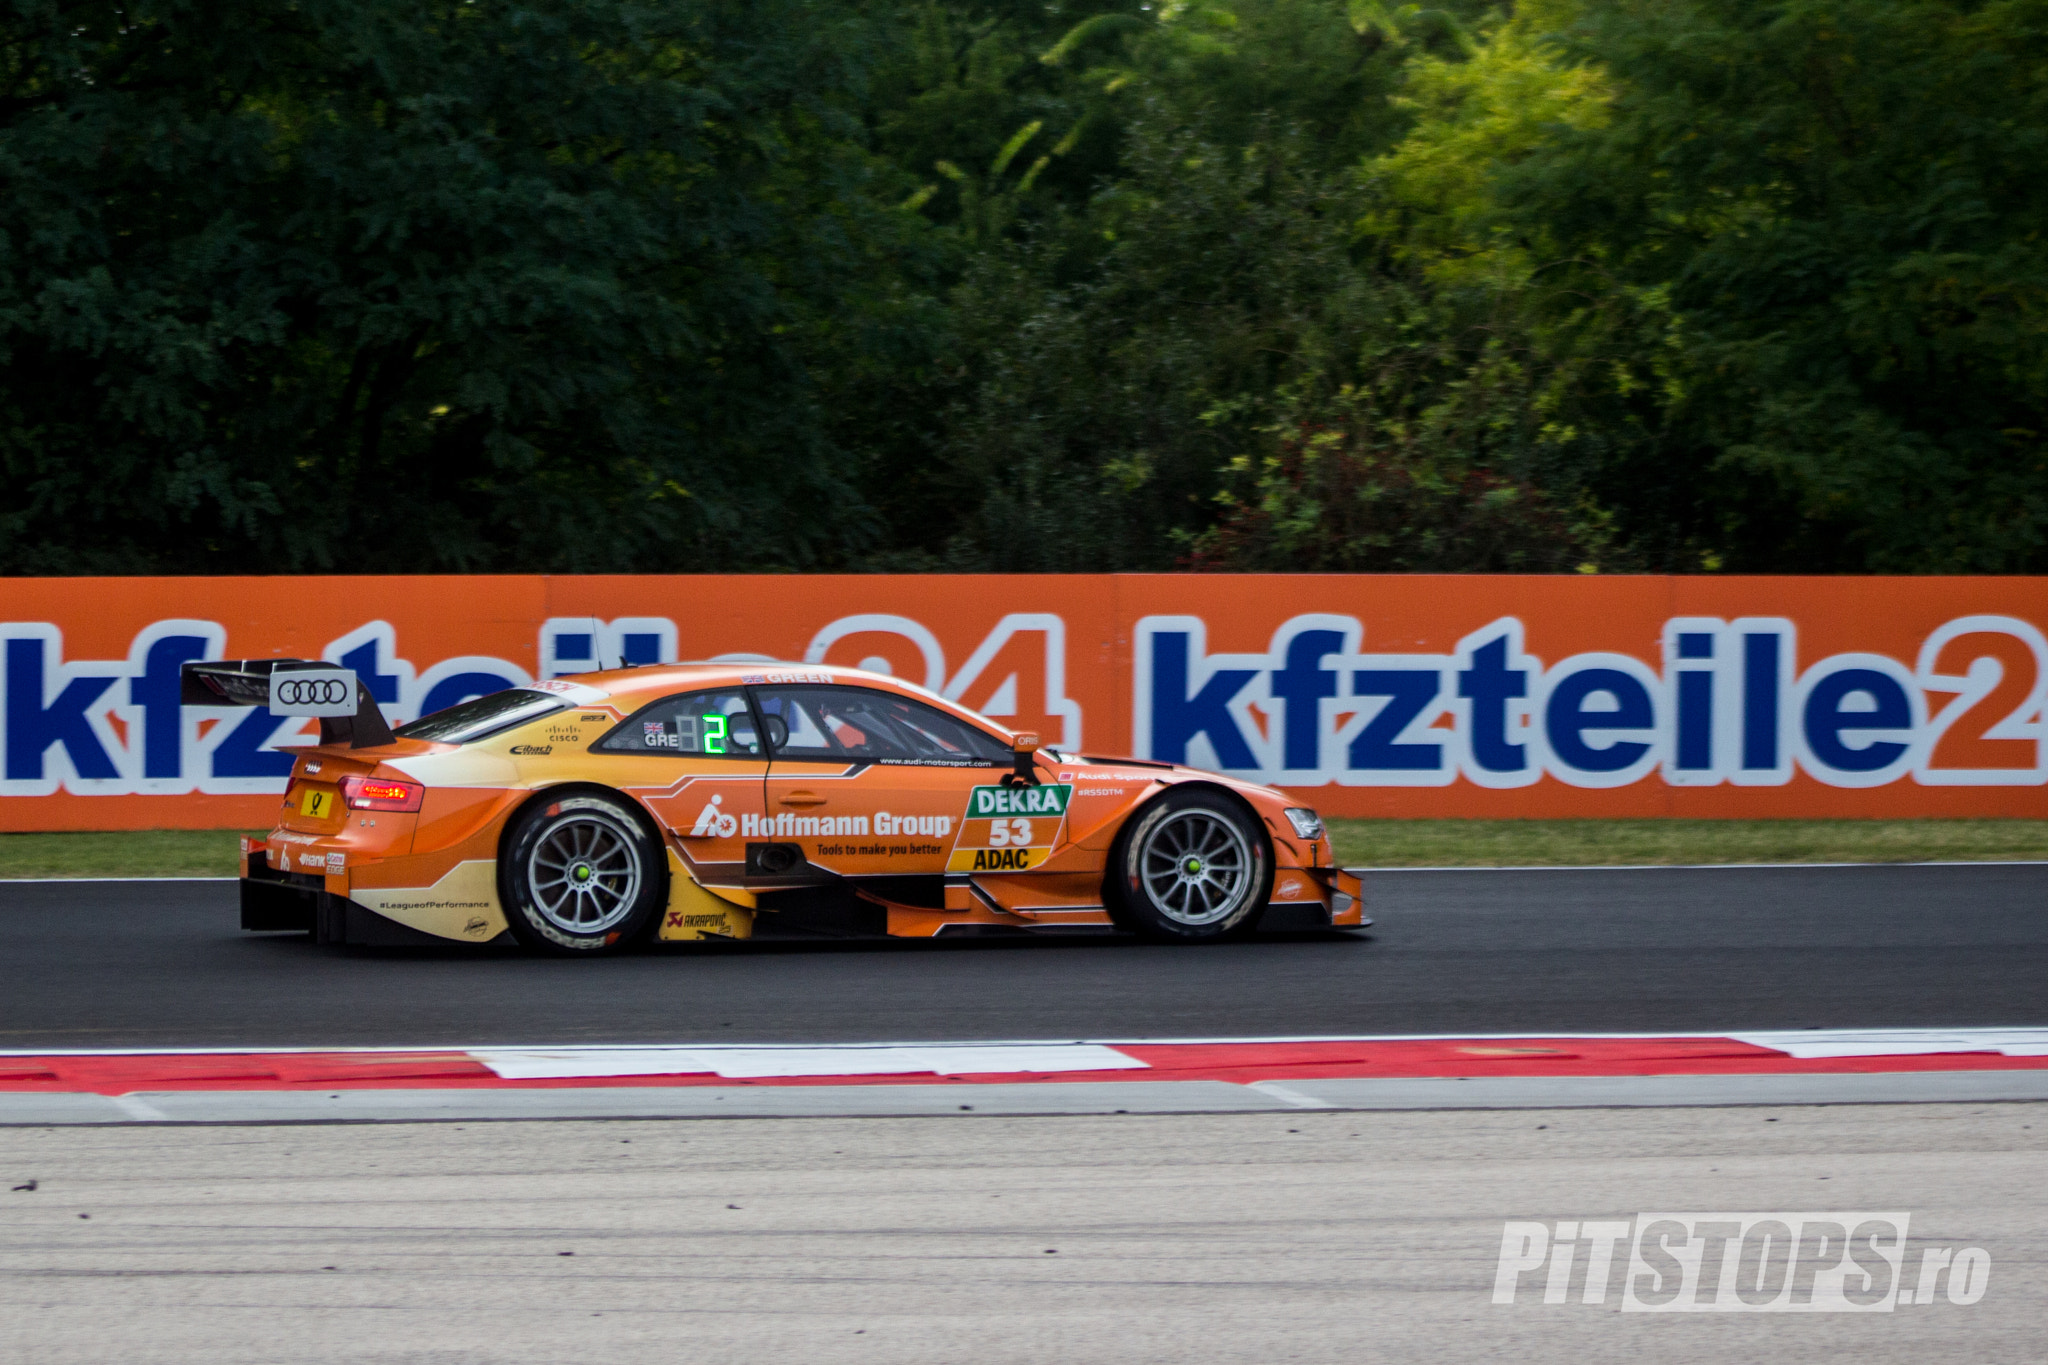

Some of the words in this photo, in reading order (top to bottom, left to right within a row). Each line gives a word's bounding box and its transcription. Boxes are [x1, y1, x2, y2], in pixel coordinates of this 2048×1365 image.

[767, 674, 833, 684] GREEN
[644, 734, 679, 747] GRE
[702, 714, 727, 754] 2
[879, 757, 992, 768] www.audi-motorsport.com
[1077, 772, 1110, 780] Audi
[977, 789, 1062, 814] DEKRA
[741, 813, 868, 837] Hoffmann
[873, 812, 951, 838] Group
[989, 818, 1033, 847] 53
[816, 844, 843, 856] Tools
[845, 845, 857, 856] to
[858, 844, 887, 856] make
[888, 846, 908, 858] you
[909, 843, 942, 856] better
[972, 848, 1029, 870] ADAC
[379, 901, 489, 911] #LeagueofPerformance
